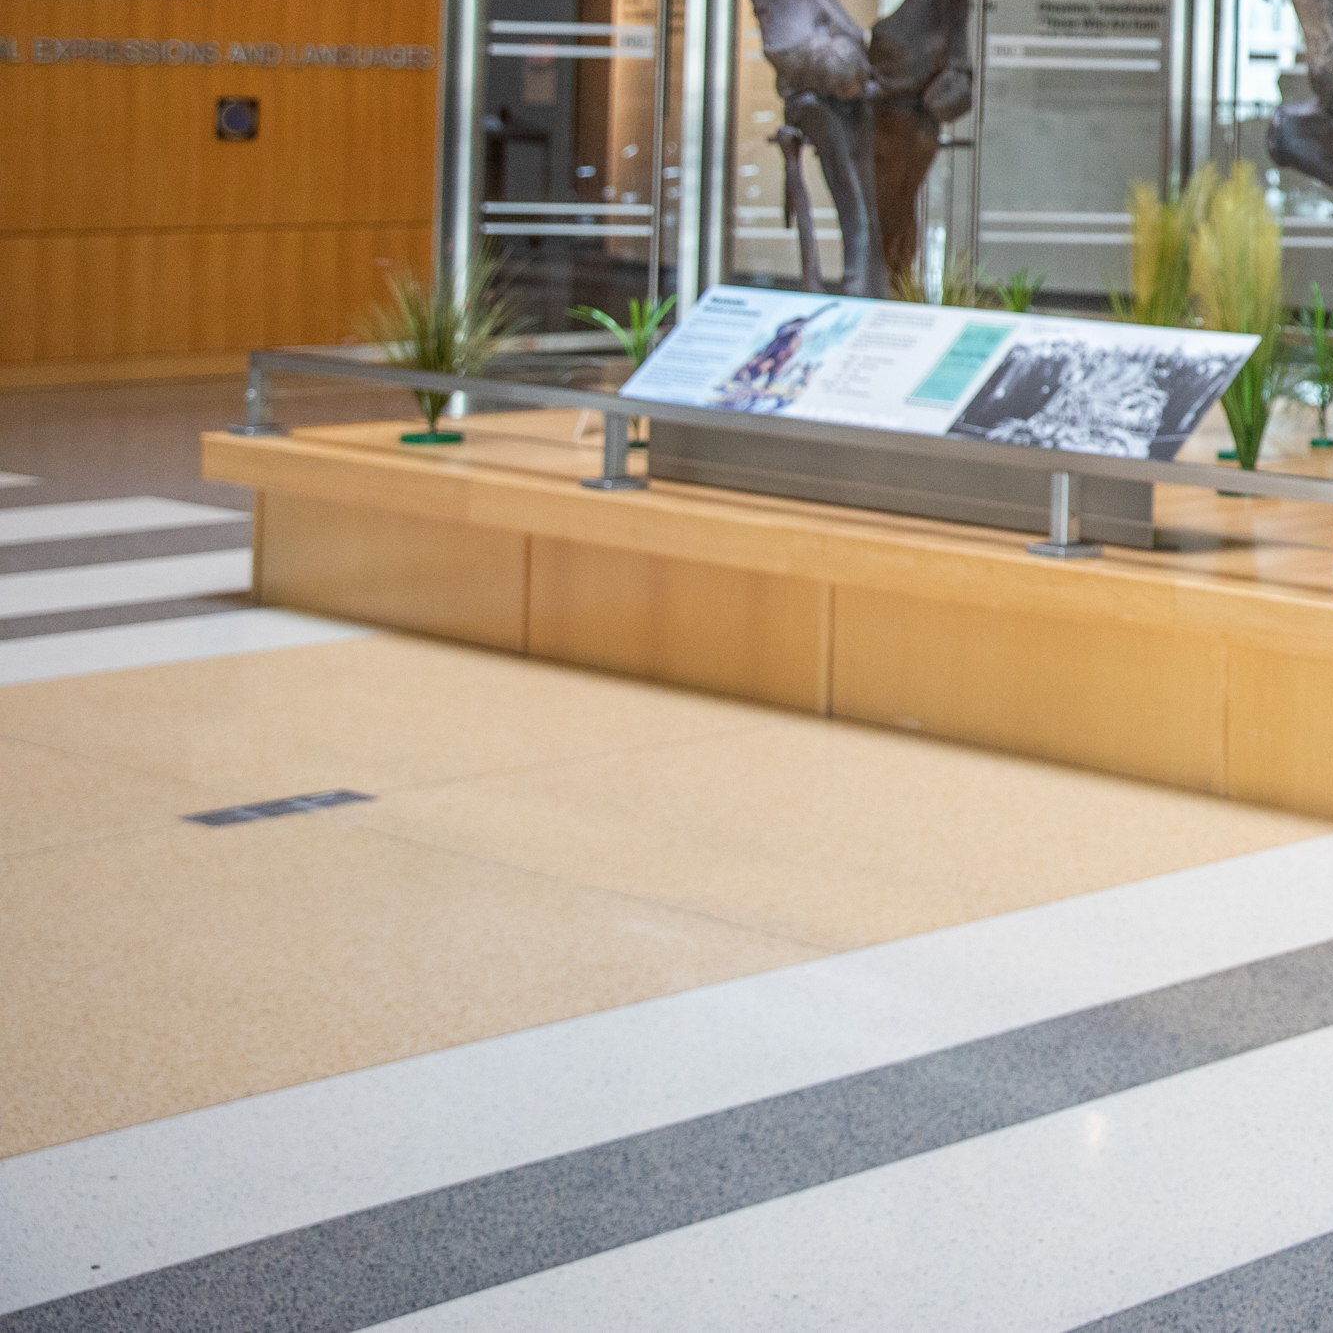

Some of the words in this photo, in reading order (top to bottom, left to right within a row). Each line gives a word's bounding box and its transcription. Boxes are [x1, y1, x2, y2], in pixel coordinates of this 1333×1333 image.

[33, 37, 221, 66] EXPRESSIONS
[228, 42, 284, 67] AND
[287, 42, 436, 70] LANGUAGES
